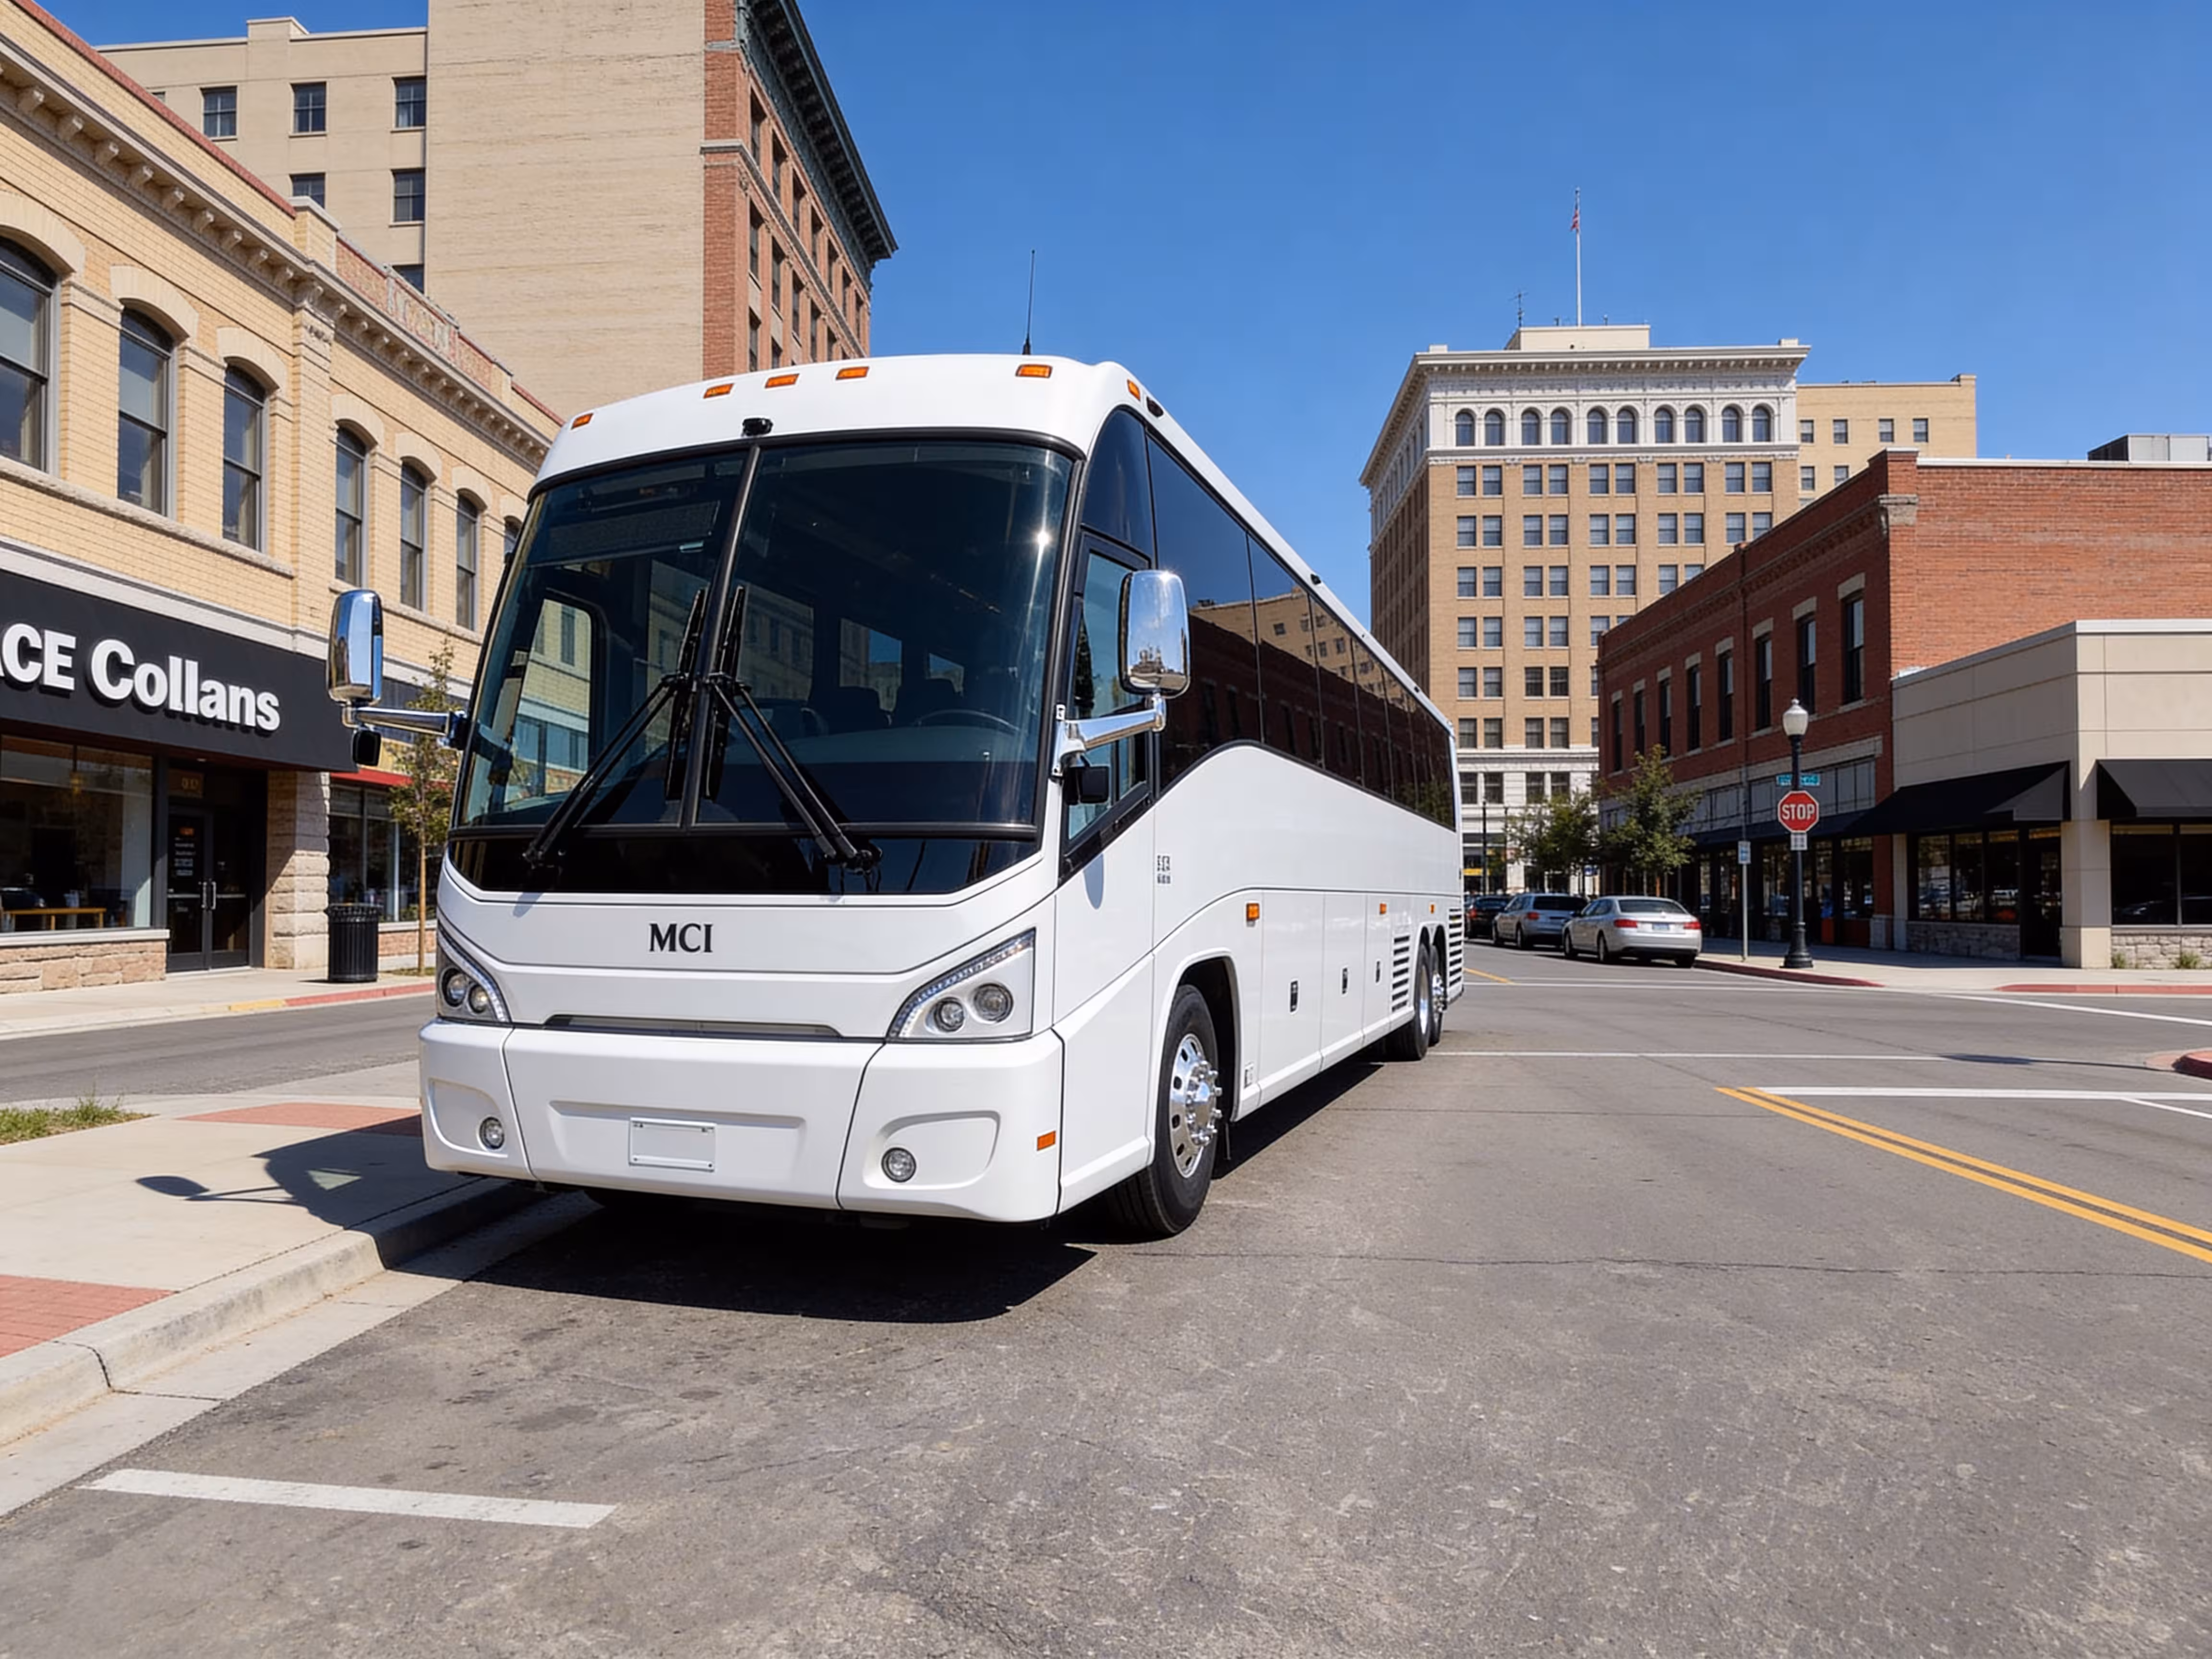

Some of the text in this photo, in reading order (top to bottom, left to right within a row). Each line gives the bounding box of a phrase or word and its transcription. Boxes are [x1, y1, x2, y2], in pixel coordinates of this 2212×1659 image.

[0, 623, 280, 731] CE Collans
[1781, 804, 1815, 820] STOP
[649, 923, 713, 953] MCI
